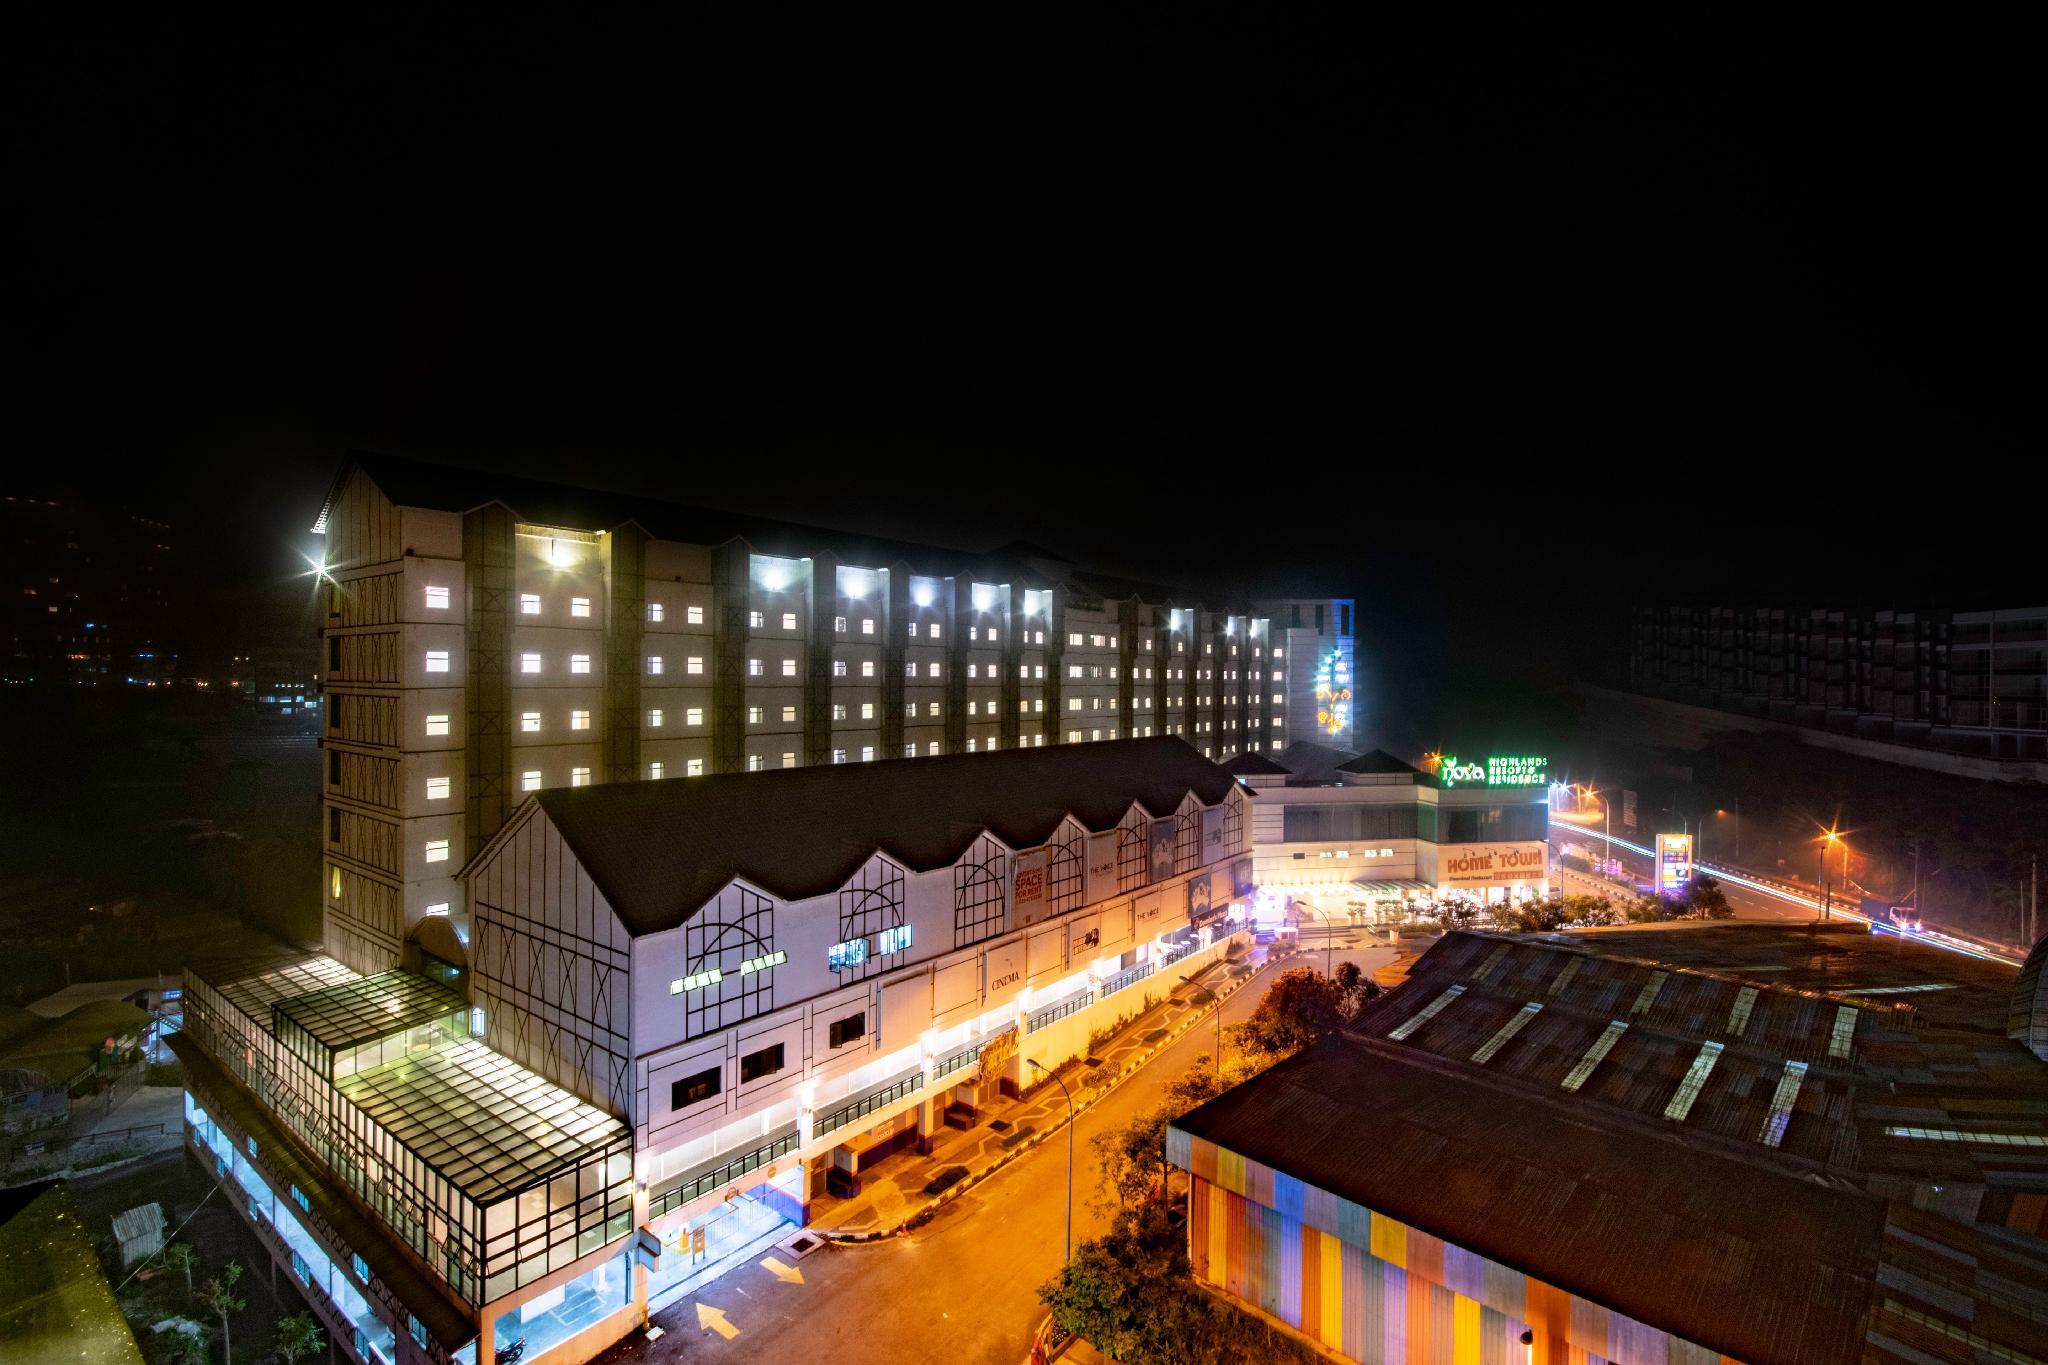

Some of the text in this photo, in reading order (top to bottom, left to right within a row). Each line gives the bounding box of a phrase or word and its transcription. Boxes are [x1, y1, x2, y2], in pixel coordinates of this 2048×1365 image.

[1489, 757, 1547, 767] HIGHLANDS
[1447, 852, 1542, 873] HOME TOWN
[1016, 874, 1042, 890] SPACE
[1016, 885, 1042, 898] FOR RENT
[991, 971, 1019, 991] CINEMA
